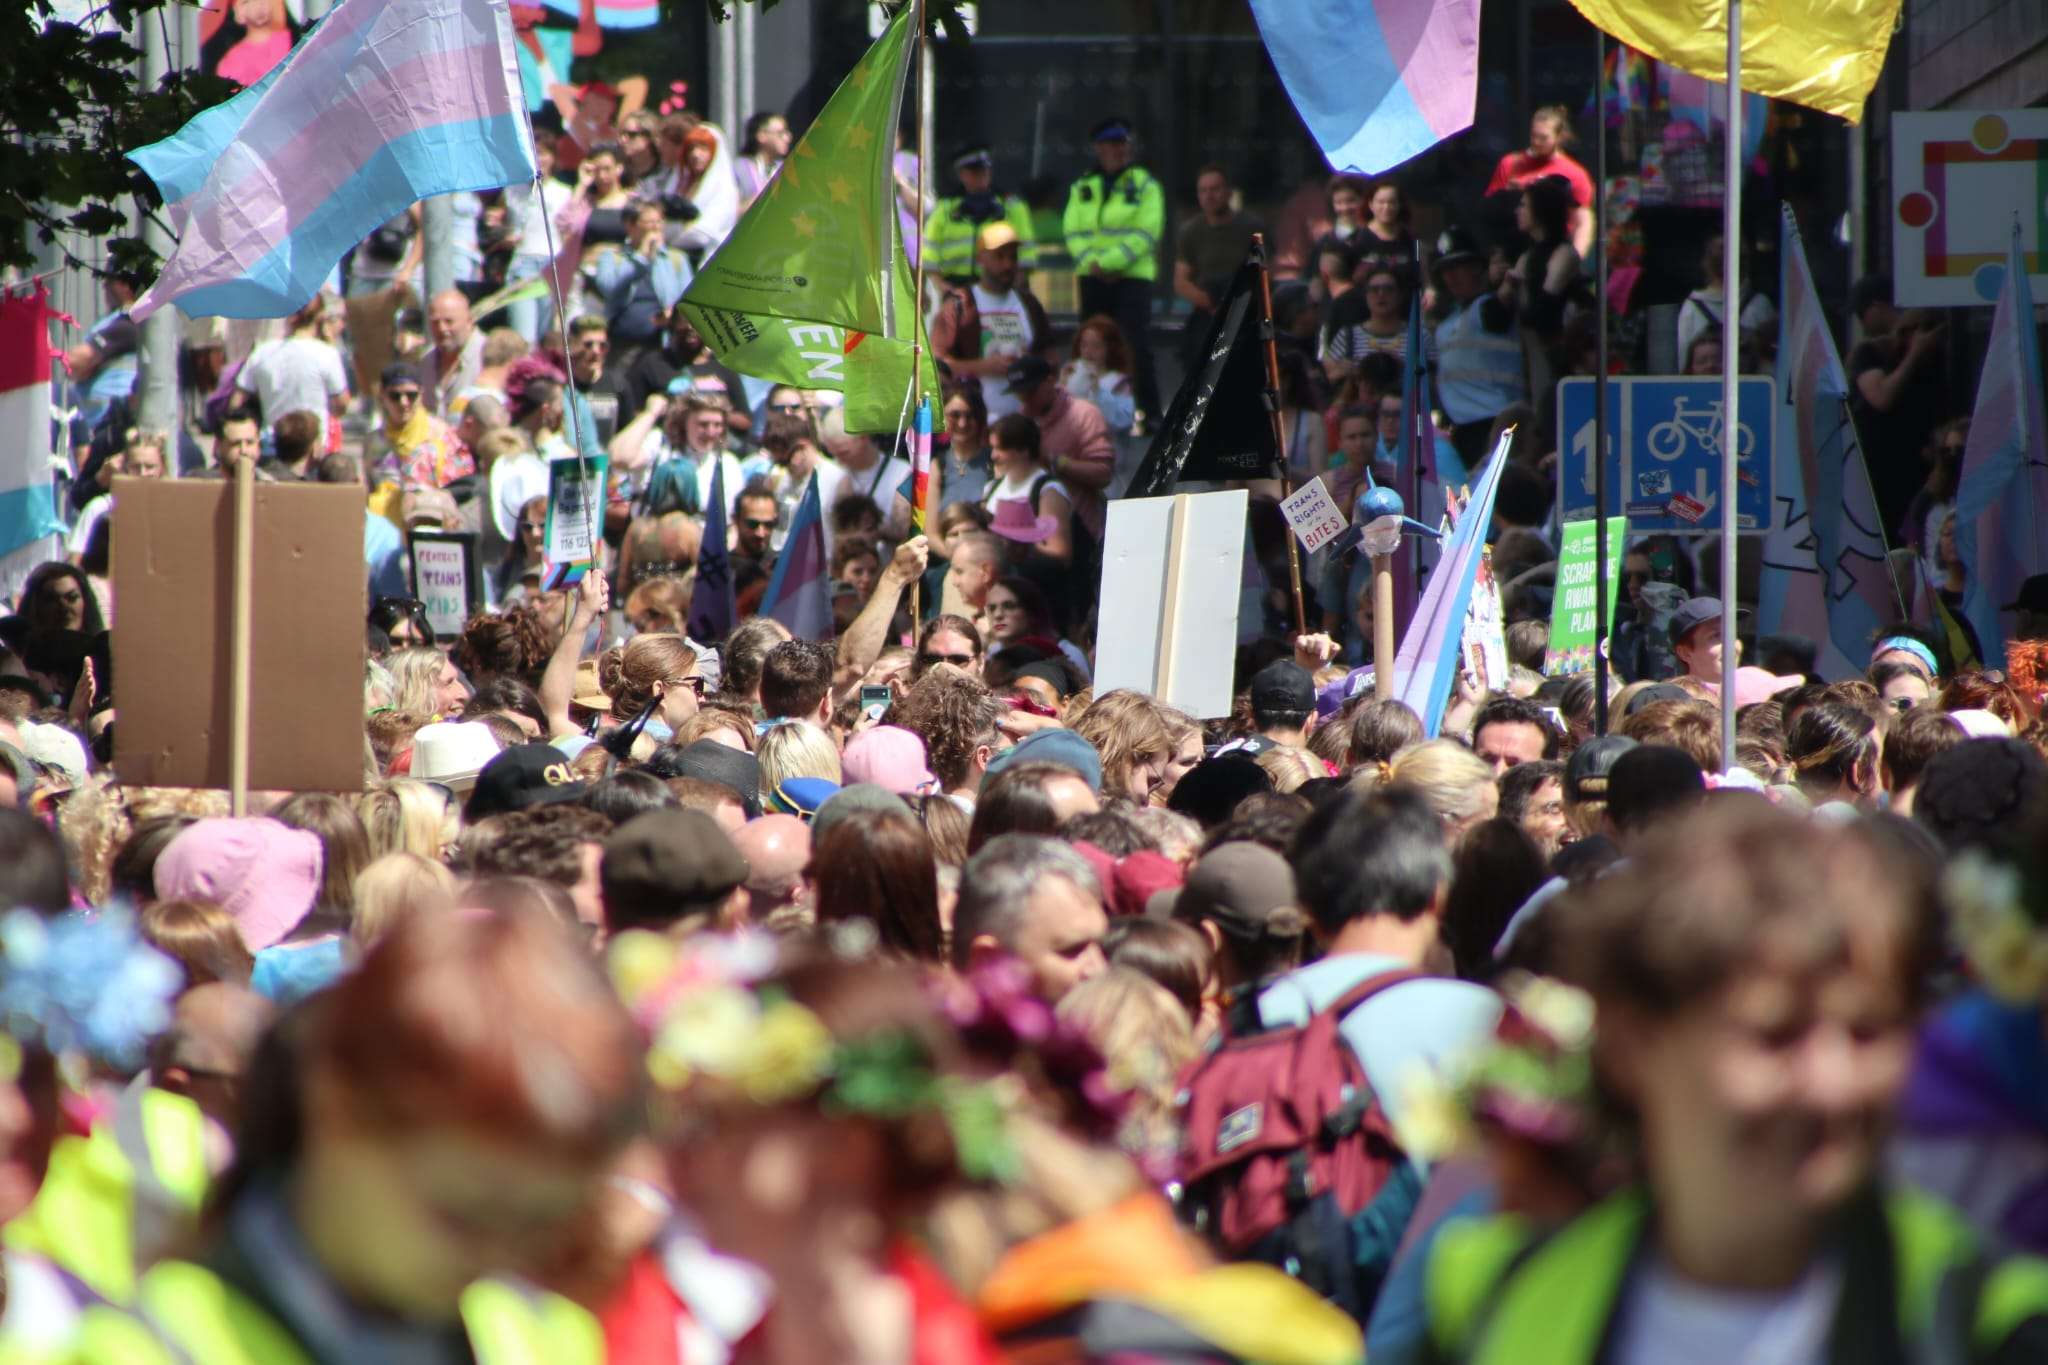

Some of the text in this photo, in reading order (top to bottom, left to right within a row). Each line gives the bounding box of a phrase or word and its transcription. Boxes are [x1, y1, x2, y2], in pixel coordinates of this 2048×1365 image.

[782, 319, 844, 381] EN
[1288, 488, 1318, 512] TRANS
[1294, 500, 1326, 523] RIGHTS
[1305, 516, 1340, 548] BITES
[1562, 560, 1596, 585] SCRAP
[1564, 585, 1597, 610] RWAN
